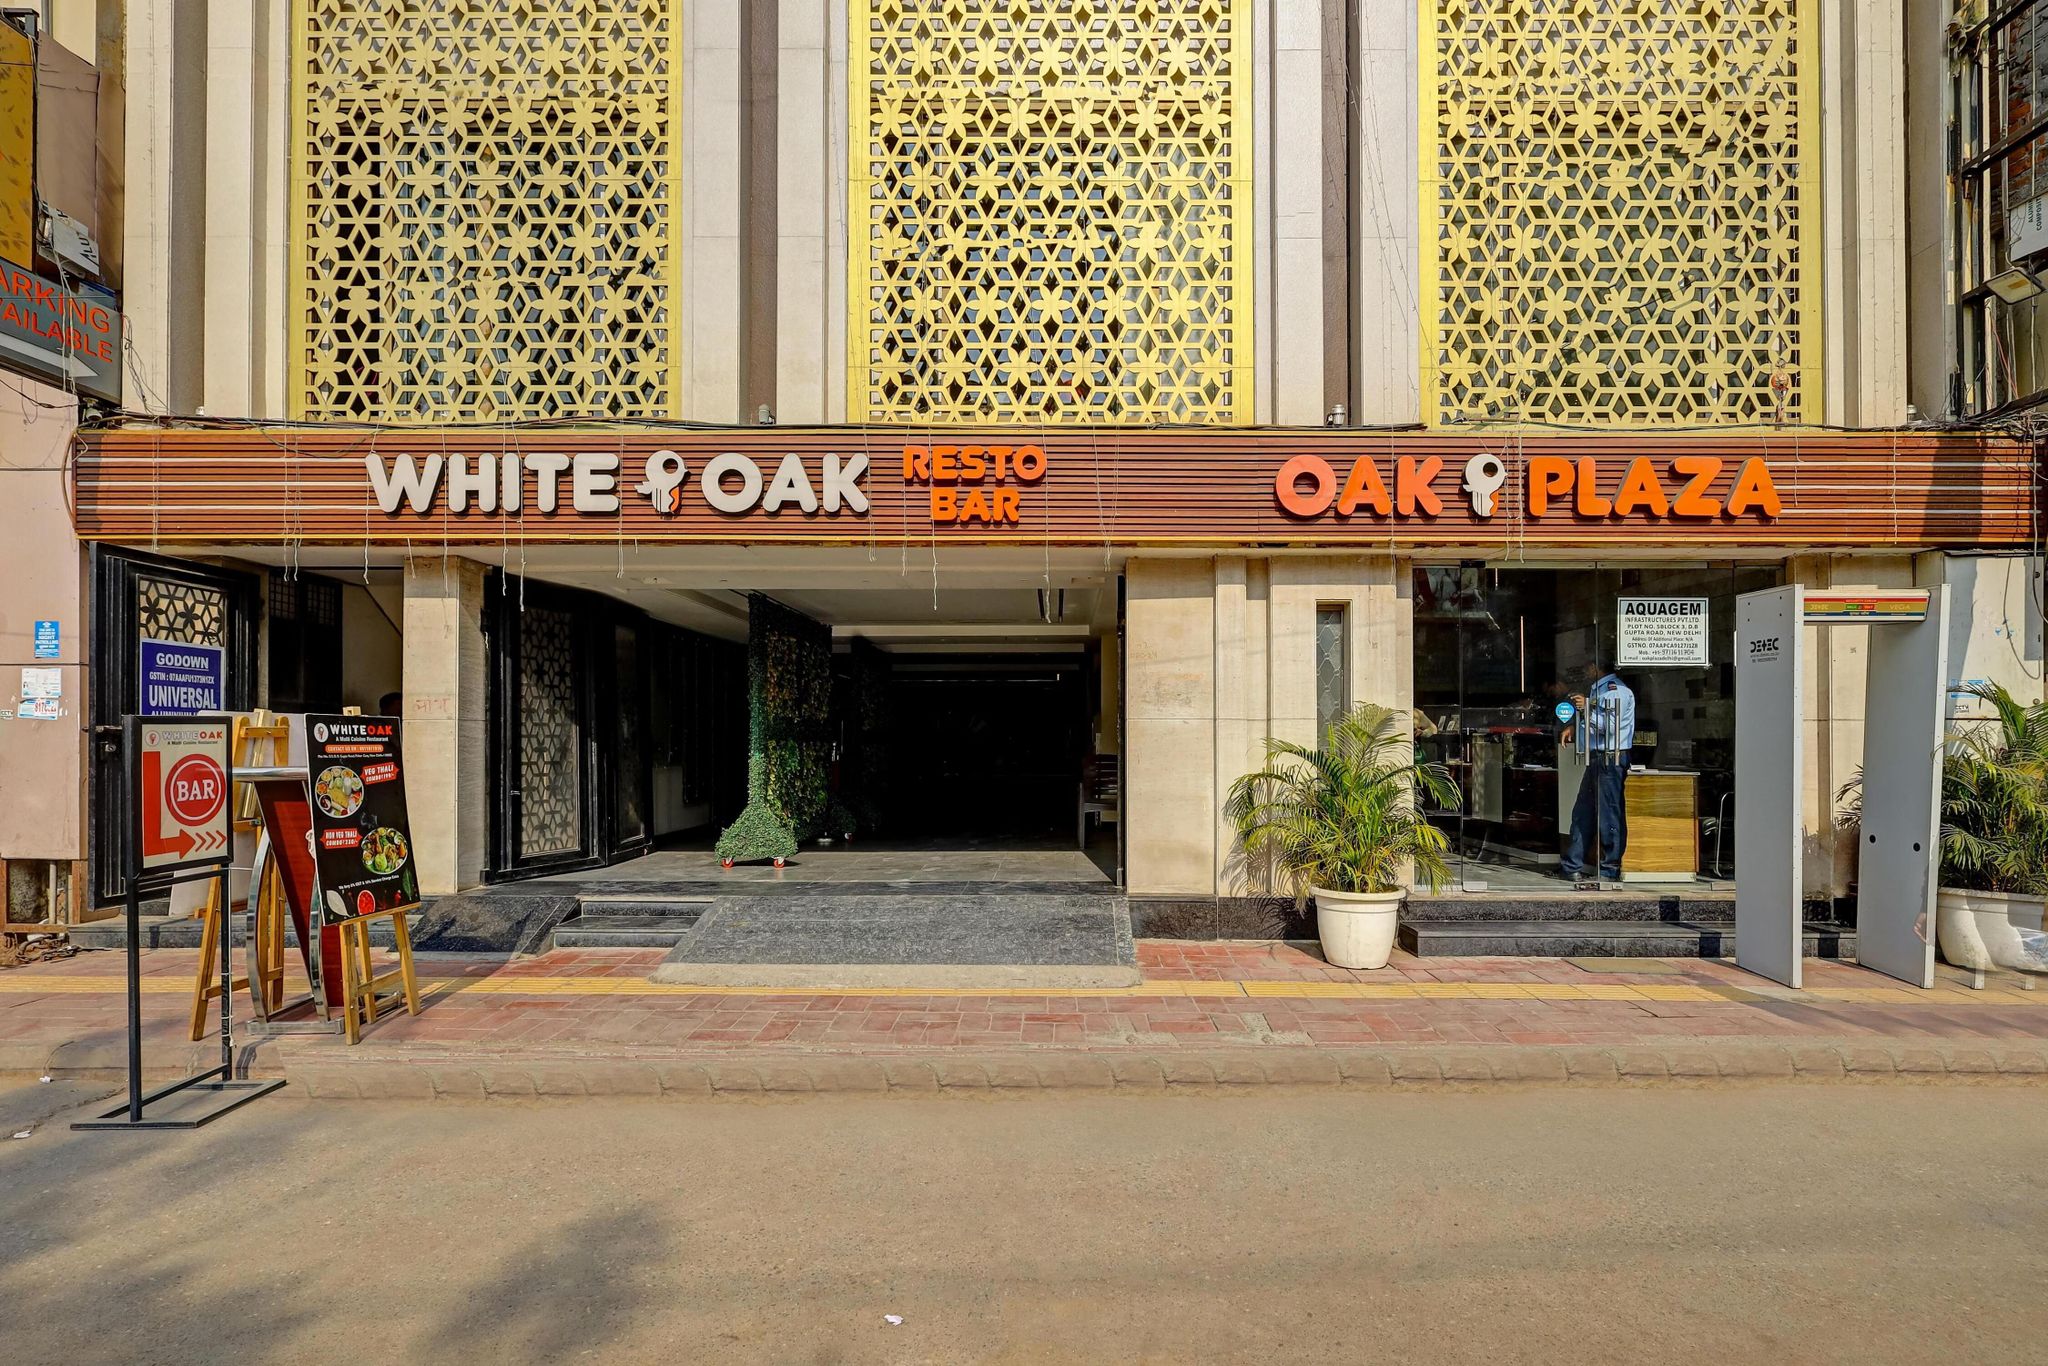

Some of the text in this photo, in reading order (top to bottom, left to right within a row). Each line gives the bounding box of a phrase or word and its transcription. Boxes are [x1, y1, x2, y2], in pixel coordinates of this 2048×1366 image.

[0, 298, 113, 363] AILABLE
[903, 444, 1047, 481] RESTO
[365, 452, 870, 514] WHITE OAK
[1275, 454, 1783, 518] OAK PLAZA
[931, 487, 1021, 522] BAR
[1625, 602, 1701, 616] AQUAGEM
[156, 652, 209, 669] GODOWN
[149, 671, 166, 681] GSTIN
[149, 685, 217, 709] UNIVERSAL
[364, 764, 394, 775] VEG THALI
[176, 779, 216, 802] BAR
